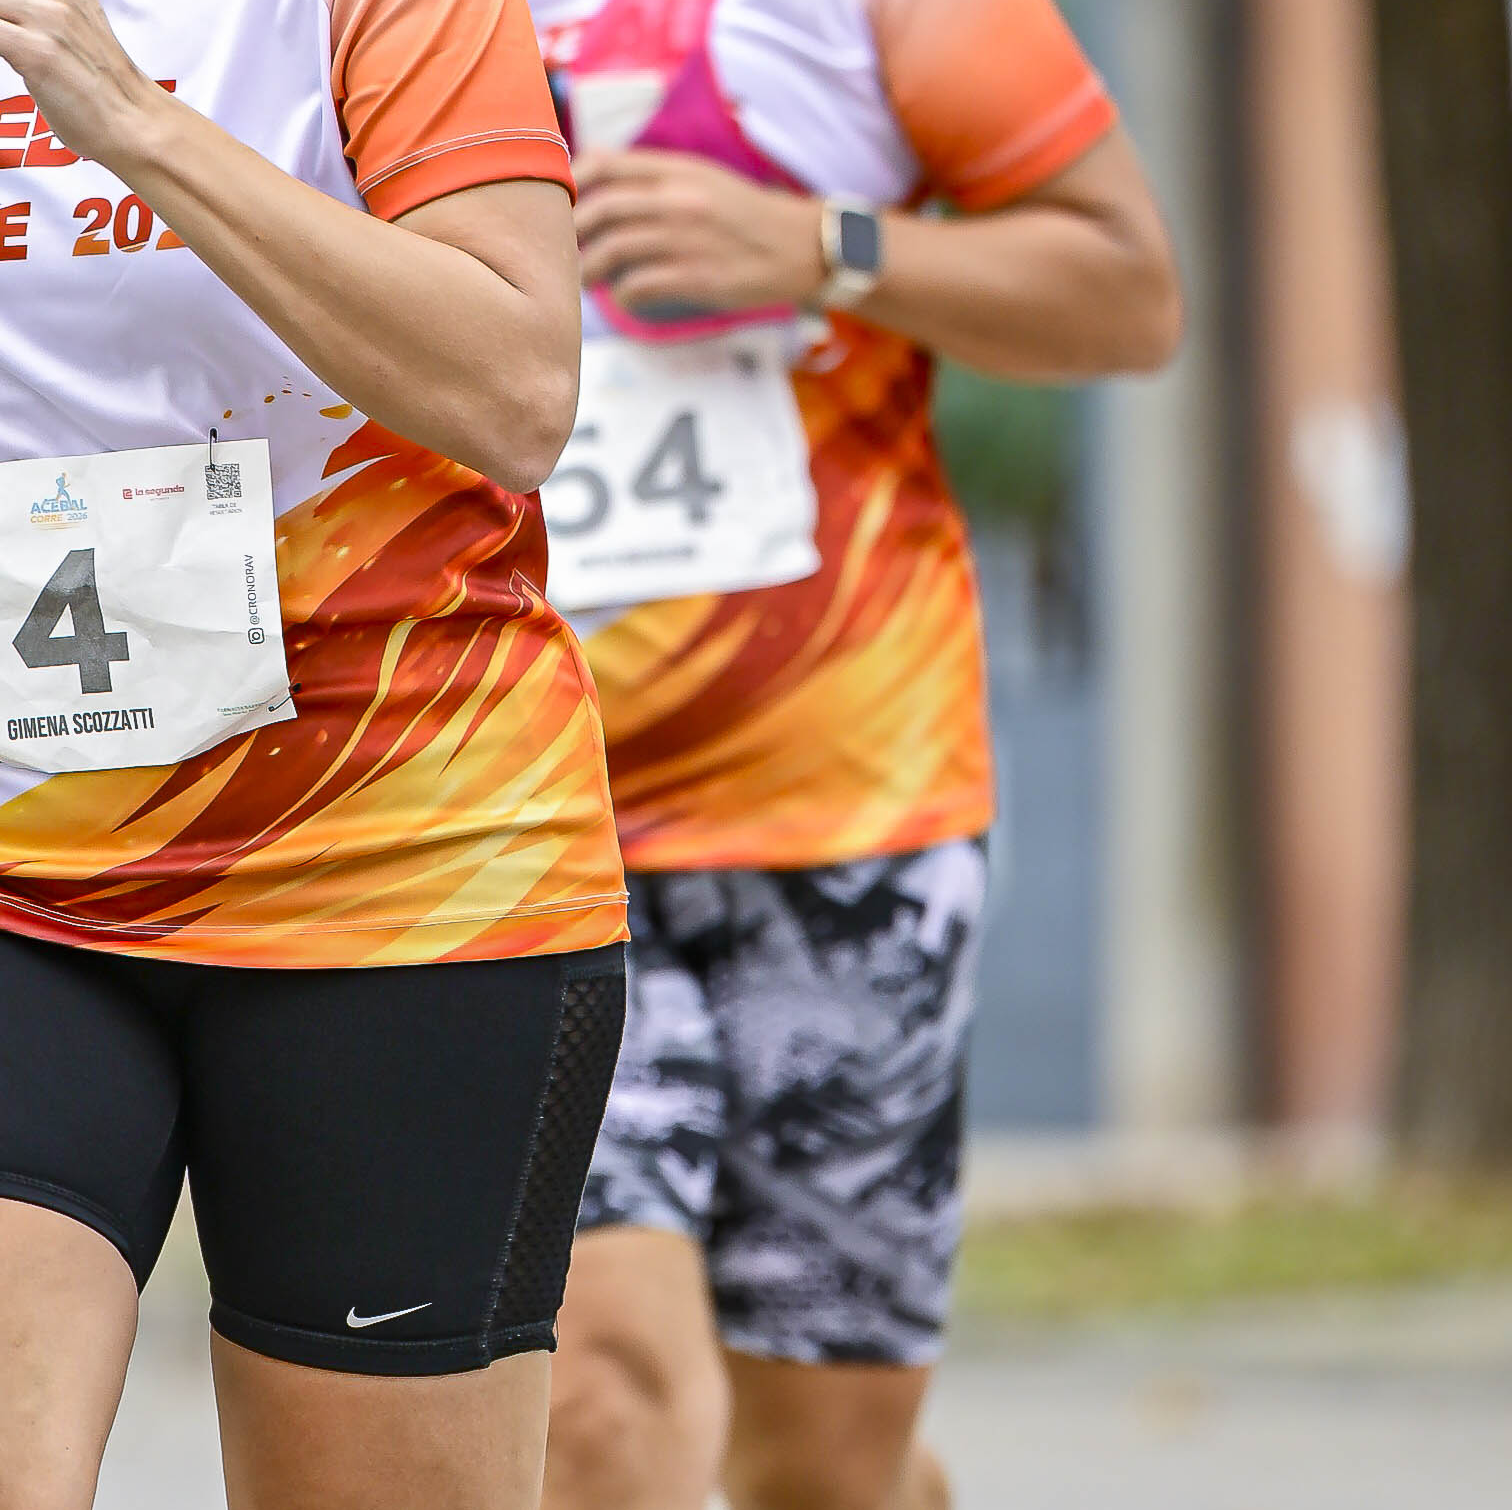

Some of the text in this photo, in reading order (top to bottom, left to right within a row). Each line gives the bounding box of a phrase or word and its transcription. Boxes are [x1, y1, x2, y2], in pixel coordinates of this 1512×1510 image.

[30, 512, 88, 523] CORRE 2026
[31, 498, 88, 514] ACEBAL
[244, 554, 261, 625] @CRONORAV
[12, 547, 130, 694] 4
[7, 707, 155, 741] GIMENA SCOZZATTI
